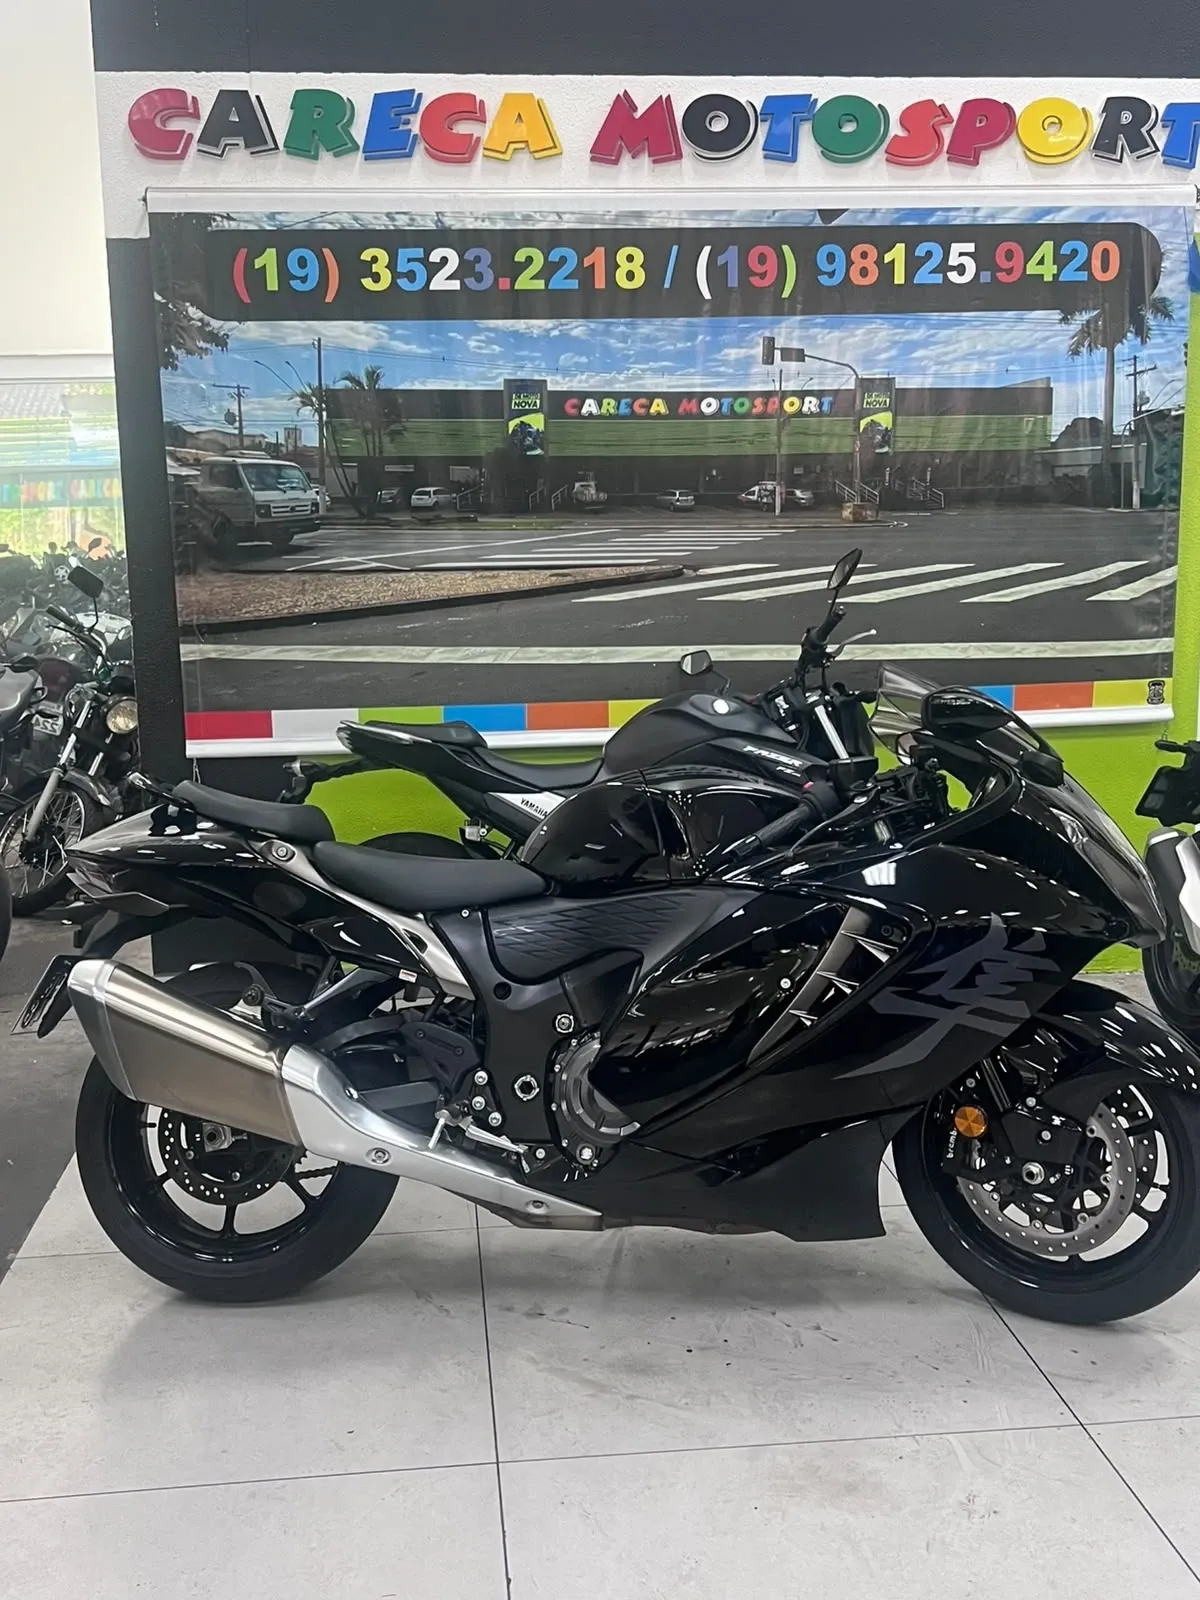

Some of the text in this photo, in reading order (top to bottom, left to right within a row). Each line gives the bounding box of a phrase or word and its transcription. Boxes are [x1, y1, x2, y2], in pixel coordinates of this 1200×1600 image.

[128, 88, 1200, 169] CARECA MOTOSPORT
[232, 240, 1121, 303] (19) 3523.2218 / (19) 98125.9420
[513, 400, 538, 409] NOVA
[564, 395, 833, 416] CARECA MOTOSPORT
[865, 399, 887, 408] NOVA
[520, 797, 548, 817] YAMAHA
